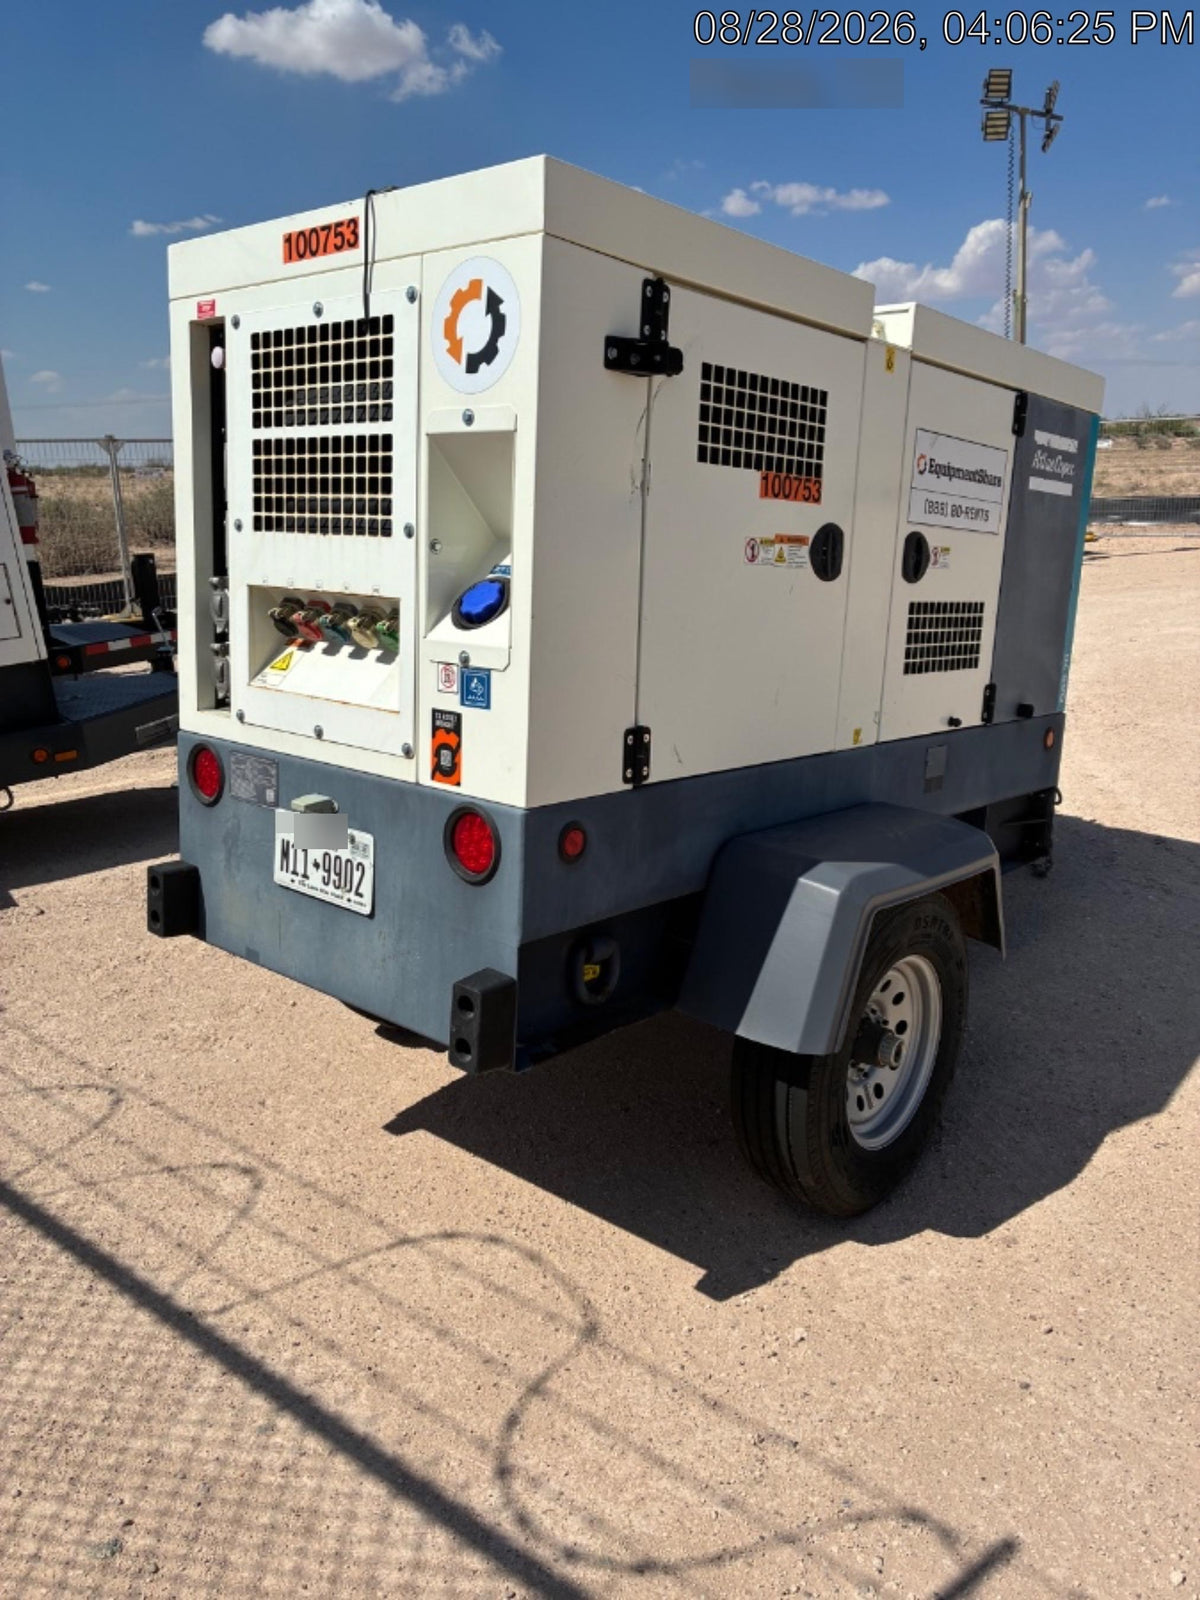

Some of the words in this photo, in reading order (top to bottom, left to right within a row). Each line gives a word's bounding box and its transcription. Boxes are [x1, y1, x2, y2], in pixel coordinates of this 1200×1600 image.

[283, 218, 358, 261] 100753
[761, 473, 823, 502] 100753
[928, 458, 1002, 487] EquipmentShare
[322, 851, 365, 898] 9902
